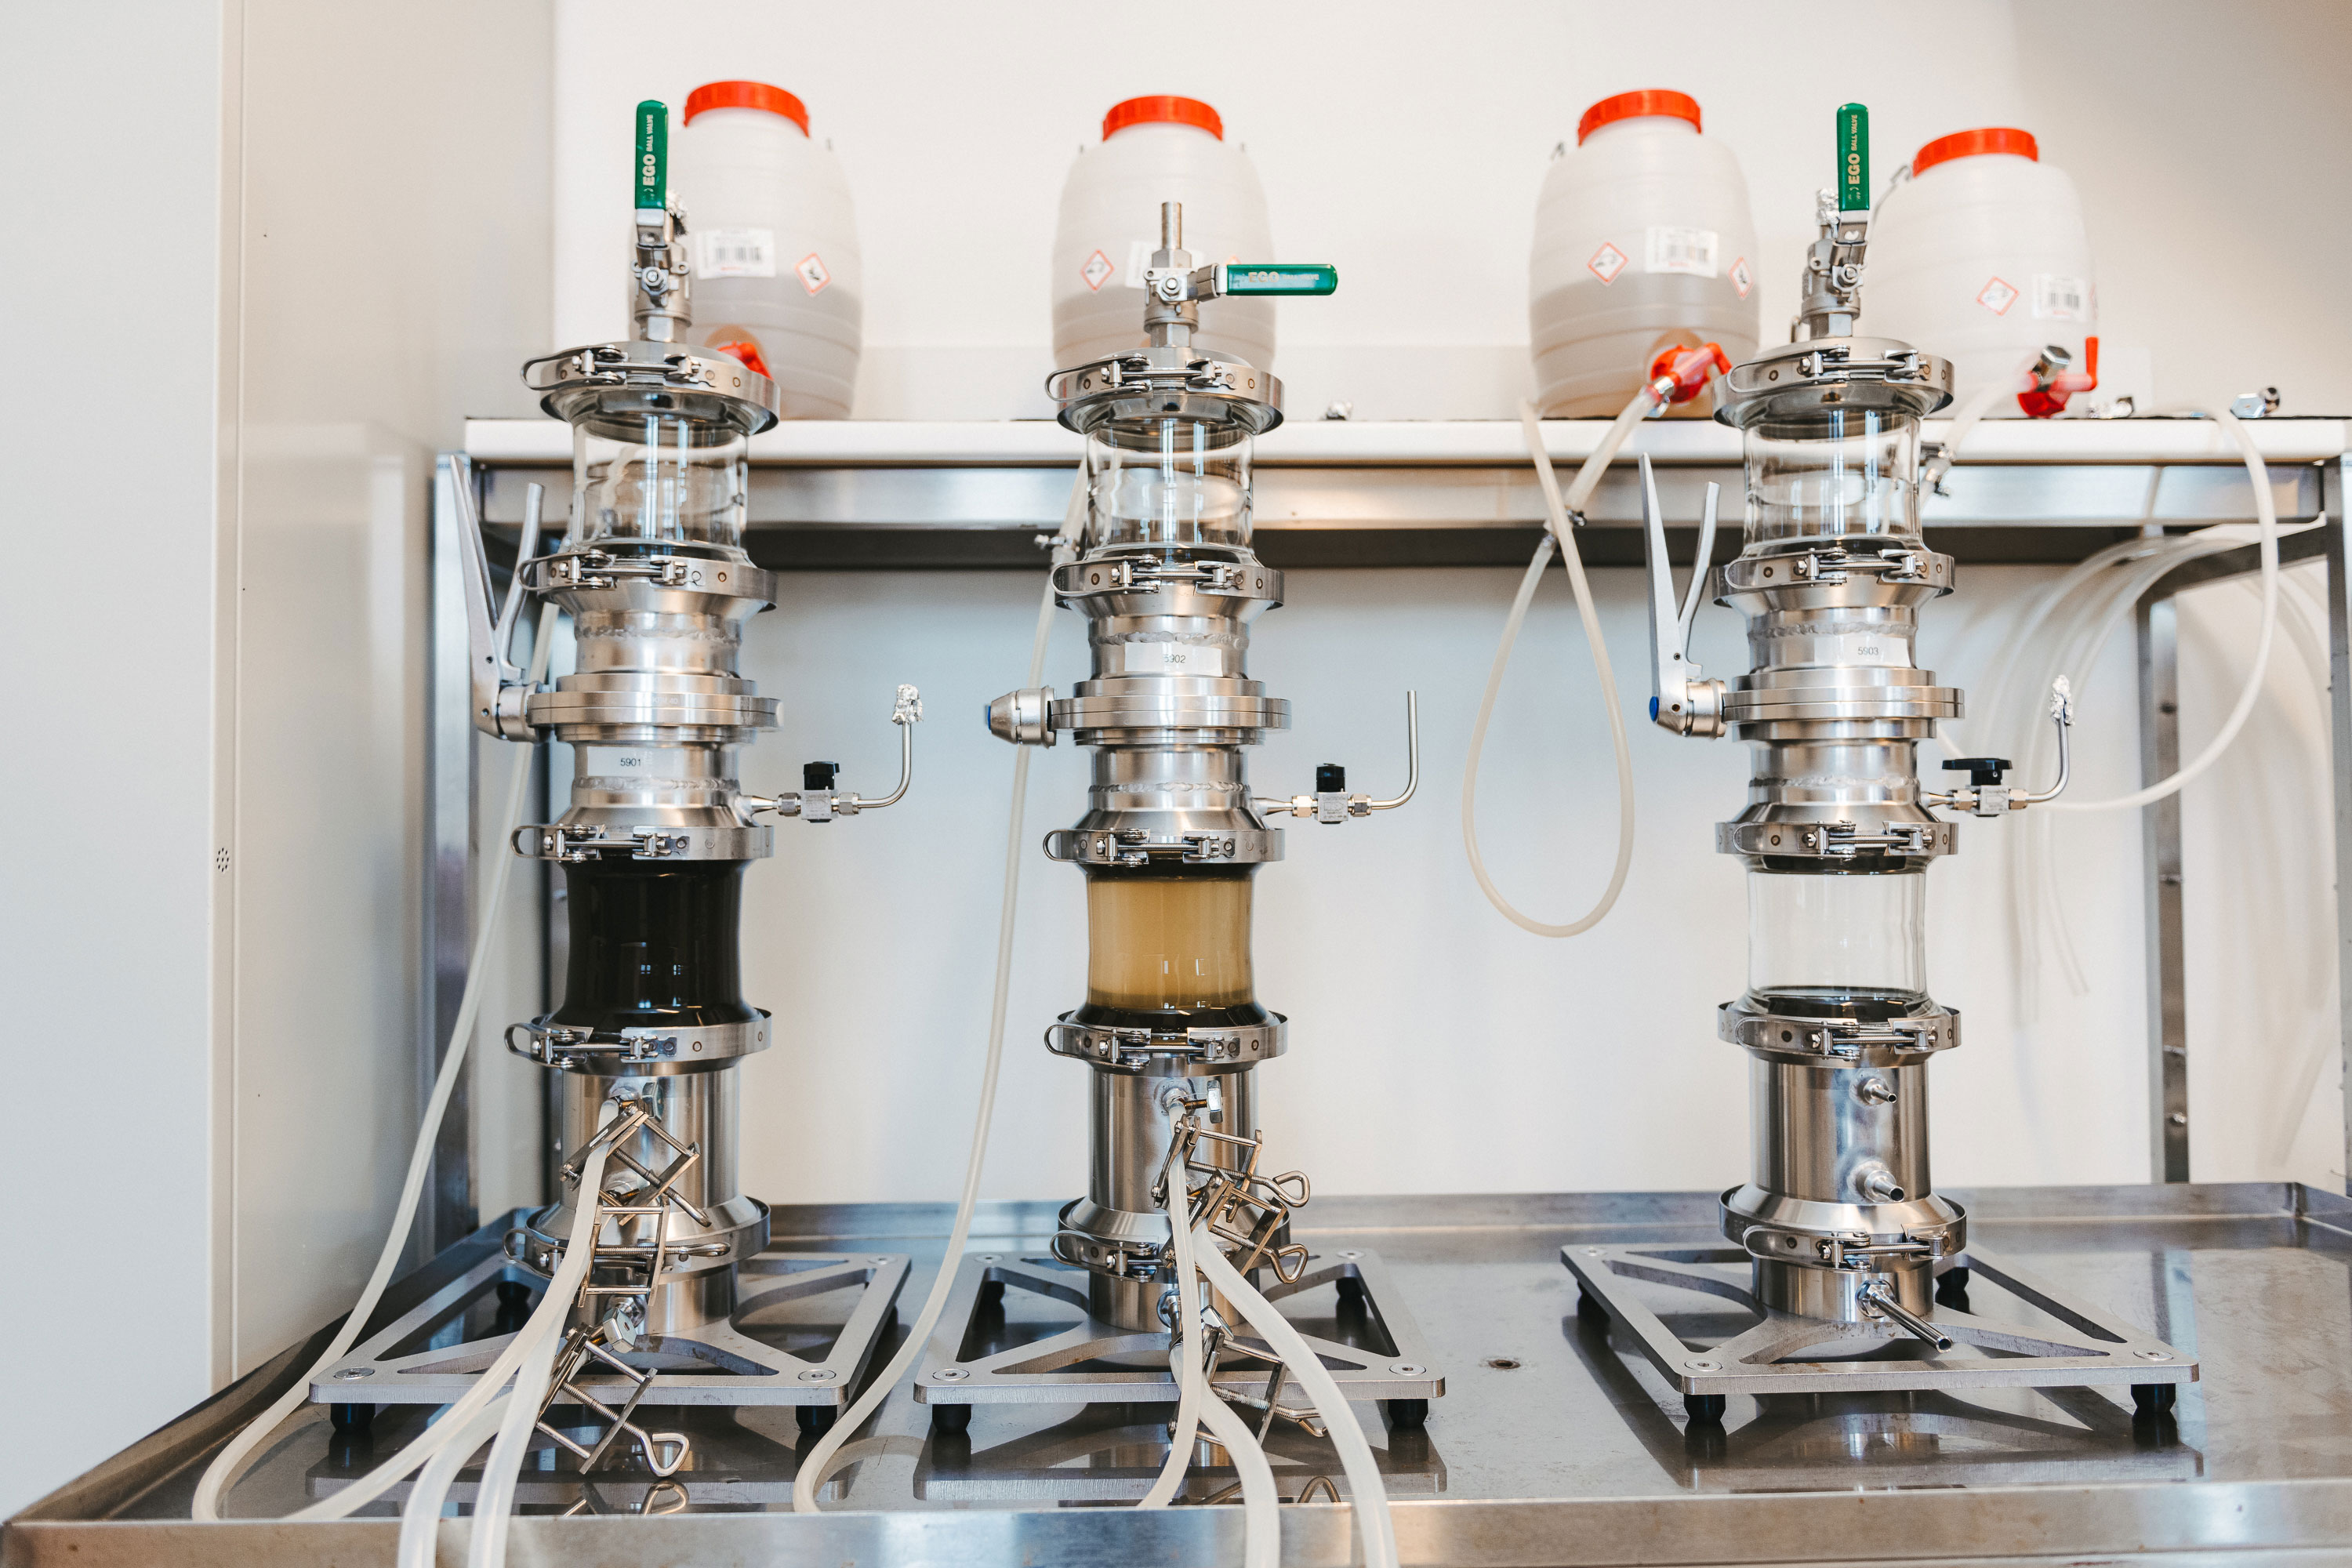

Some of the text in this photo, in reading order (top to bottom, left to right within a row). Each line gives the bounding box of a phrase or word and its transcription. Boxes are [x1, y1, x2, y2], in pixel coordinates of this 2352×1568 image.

[642, 154, 656, 186] EGO
[1847, 153, 1860, 185] EGO
[1248, 271, 1280, 283] EGO
[1857, 646, 1879, 655] 5903
[620, 757, 641, 767] 5901
